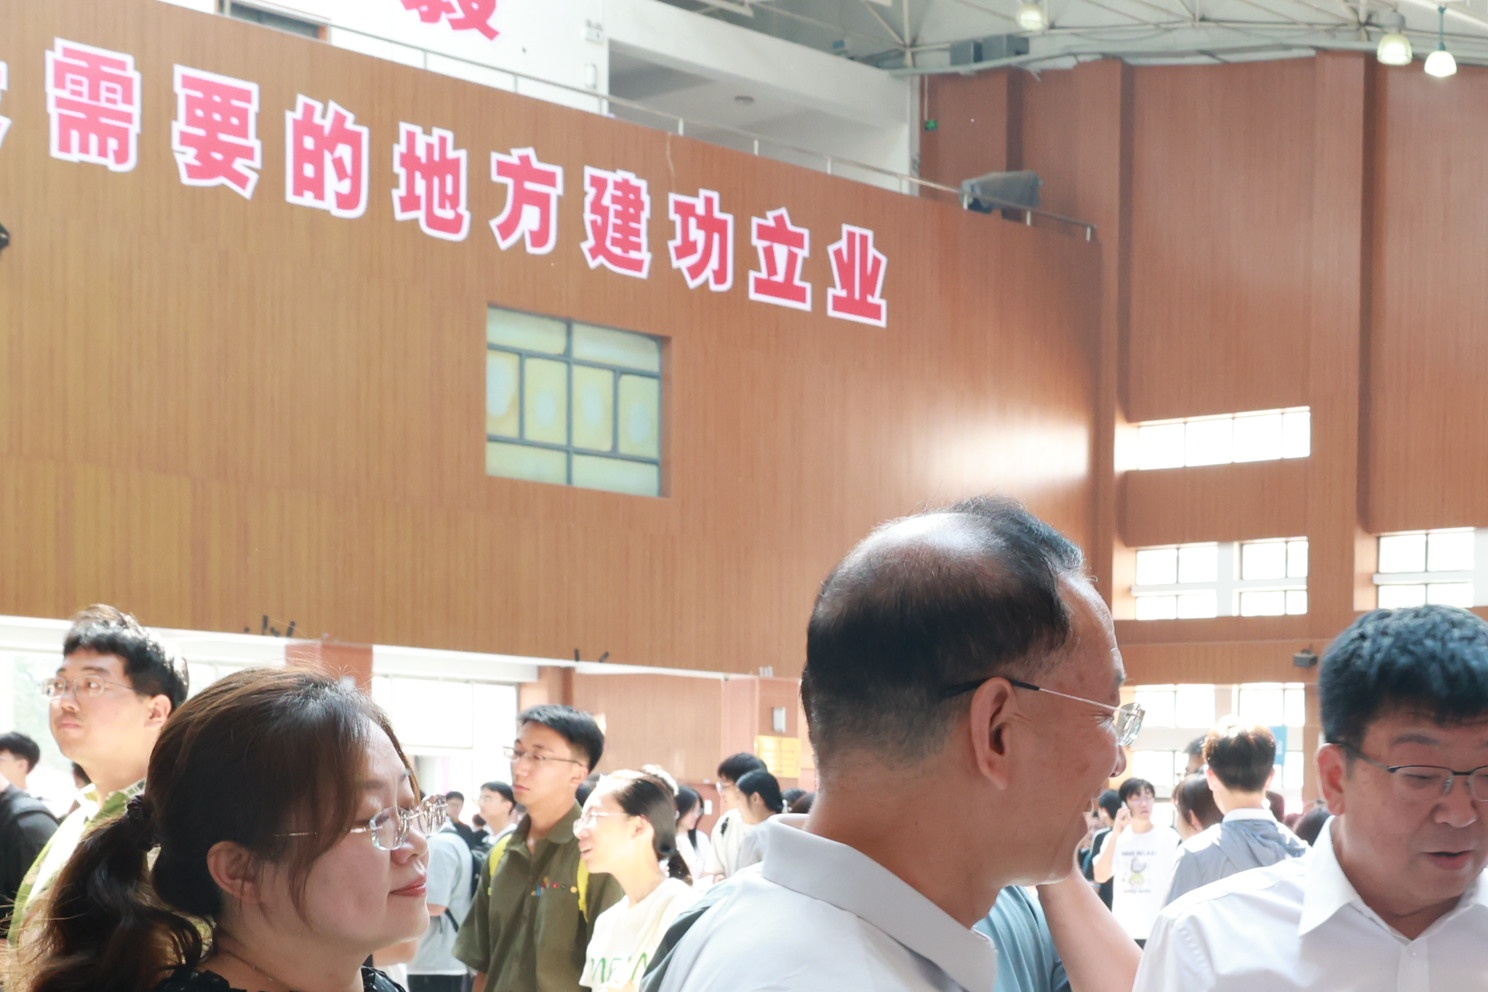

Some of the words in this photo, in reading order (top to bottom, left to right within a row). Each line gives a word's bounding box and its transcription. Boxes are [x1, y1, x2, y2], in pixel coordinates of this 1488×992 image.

[0, 37, 888, 328] 需要的地方建功立业
